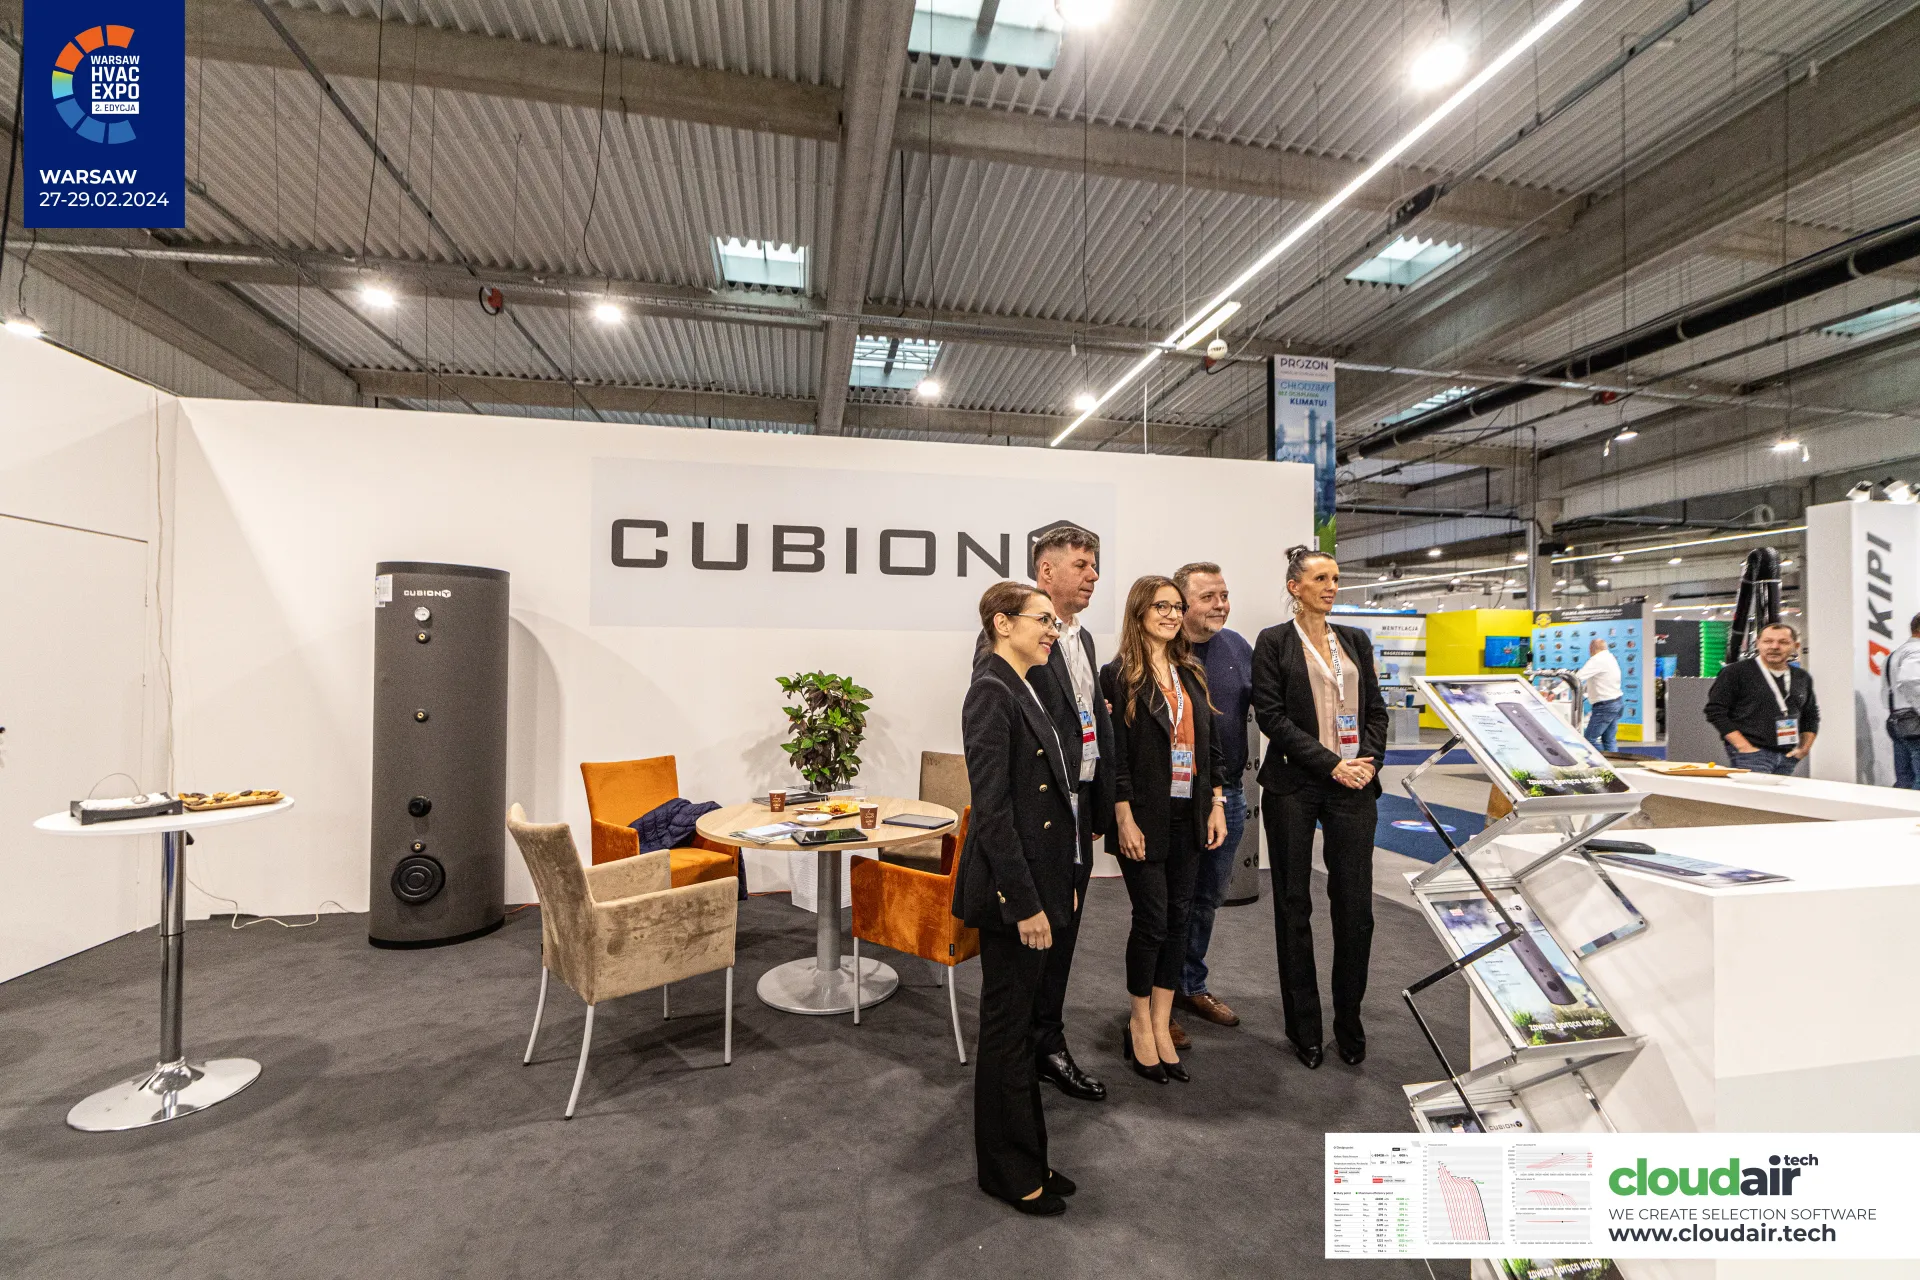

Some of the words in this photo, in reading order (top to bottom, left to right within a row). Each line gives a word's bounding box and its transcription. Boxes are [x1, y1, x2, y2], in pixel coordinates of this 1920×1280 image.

[1280, 357, 1329, 371] PROZON
[1290, 398, 1328, 407] KLIMATU!
[611, 518, 1010, 579] CUBION
[403, 589, 442, 597] CUBION
[1866, 531, 1893, 641] KIPI
